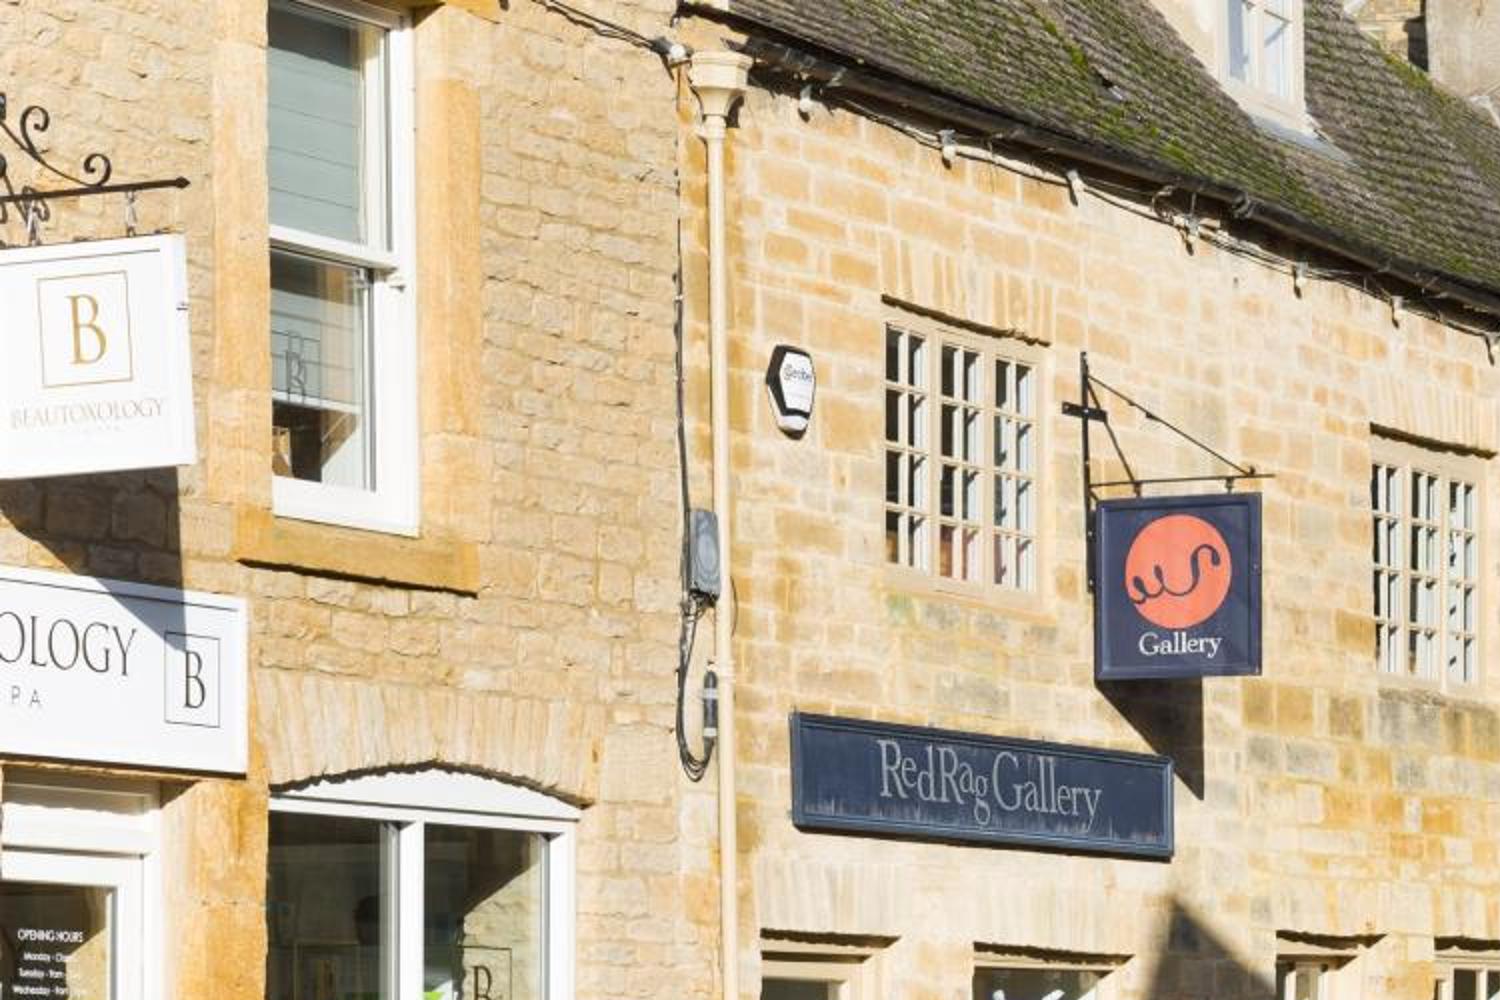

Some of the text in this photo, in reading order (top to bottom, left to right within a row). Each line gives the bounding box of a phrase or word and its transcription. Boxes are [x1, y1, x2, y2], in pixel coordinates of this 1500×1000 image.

[65, 294, 107, 365] B
[1138, 631, 1223, 659] Gallery
[184, 650, 207, 709] B
